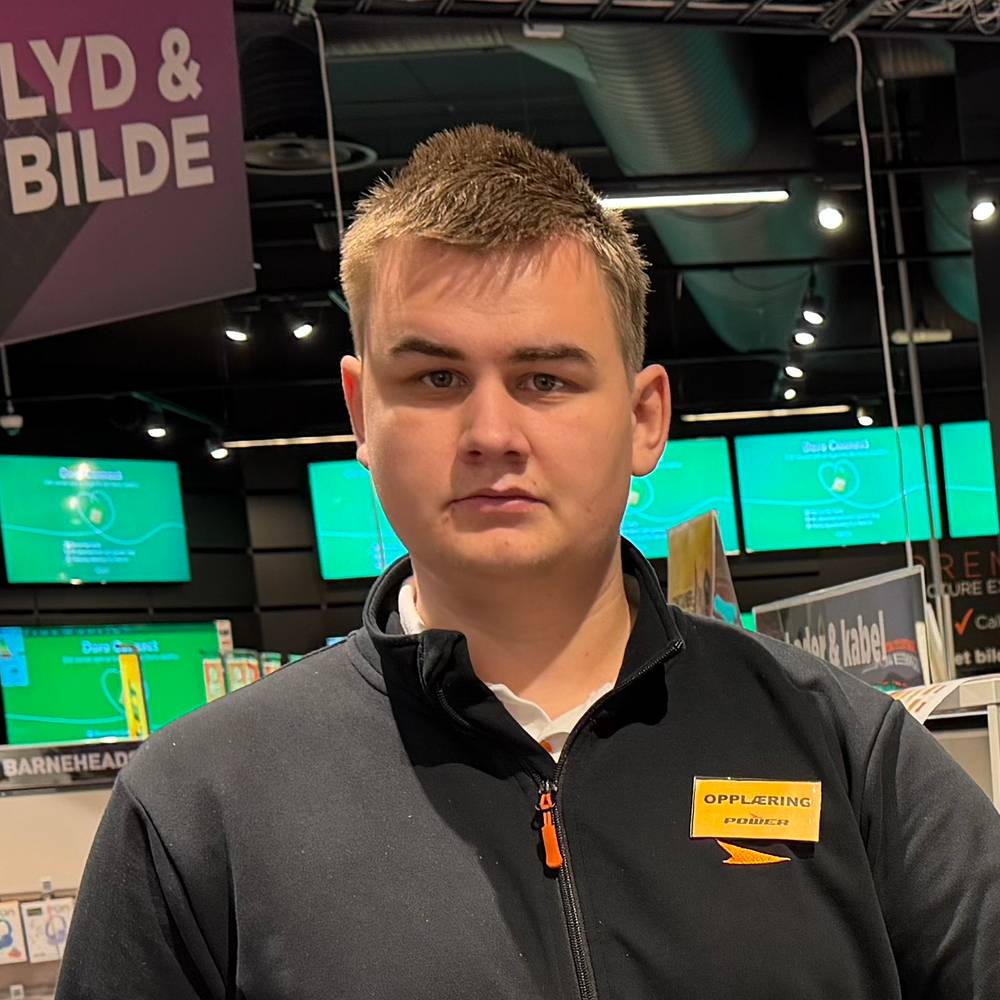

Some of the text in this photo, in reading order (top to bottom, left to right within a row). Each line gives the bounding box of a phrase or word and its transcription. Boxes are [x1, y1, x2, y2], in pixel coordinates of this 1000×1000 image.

[0, 27, 202, 120] LYD &
[4, 115, 215, 215] BILDE
[840, 609, 887, 667] kabel
[703, 793, 812, 808] OPPLÆRING
[723, 816, 790, 827] POWER
